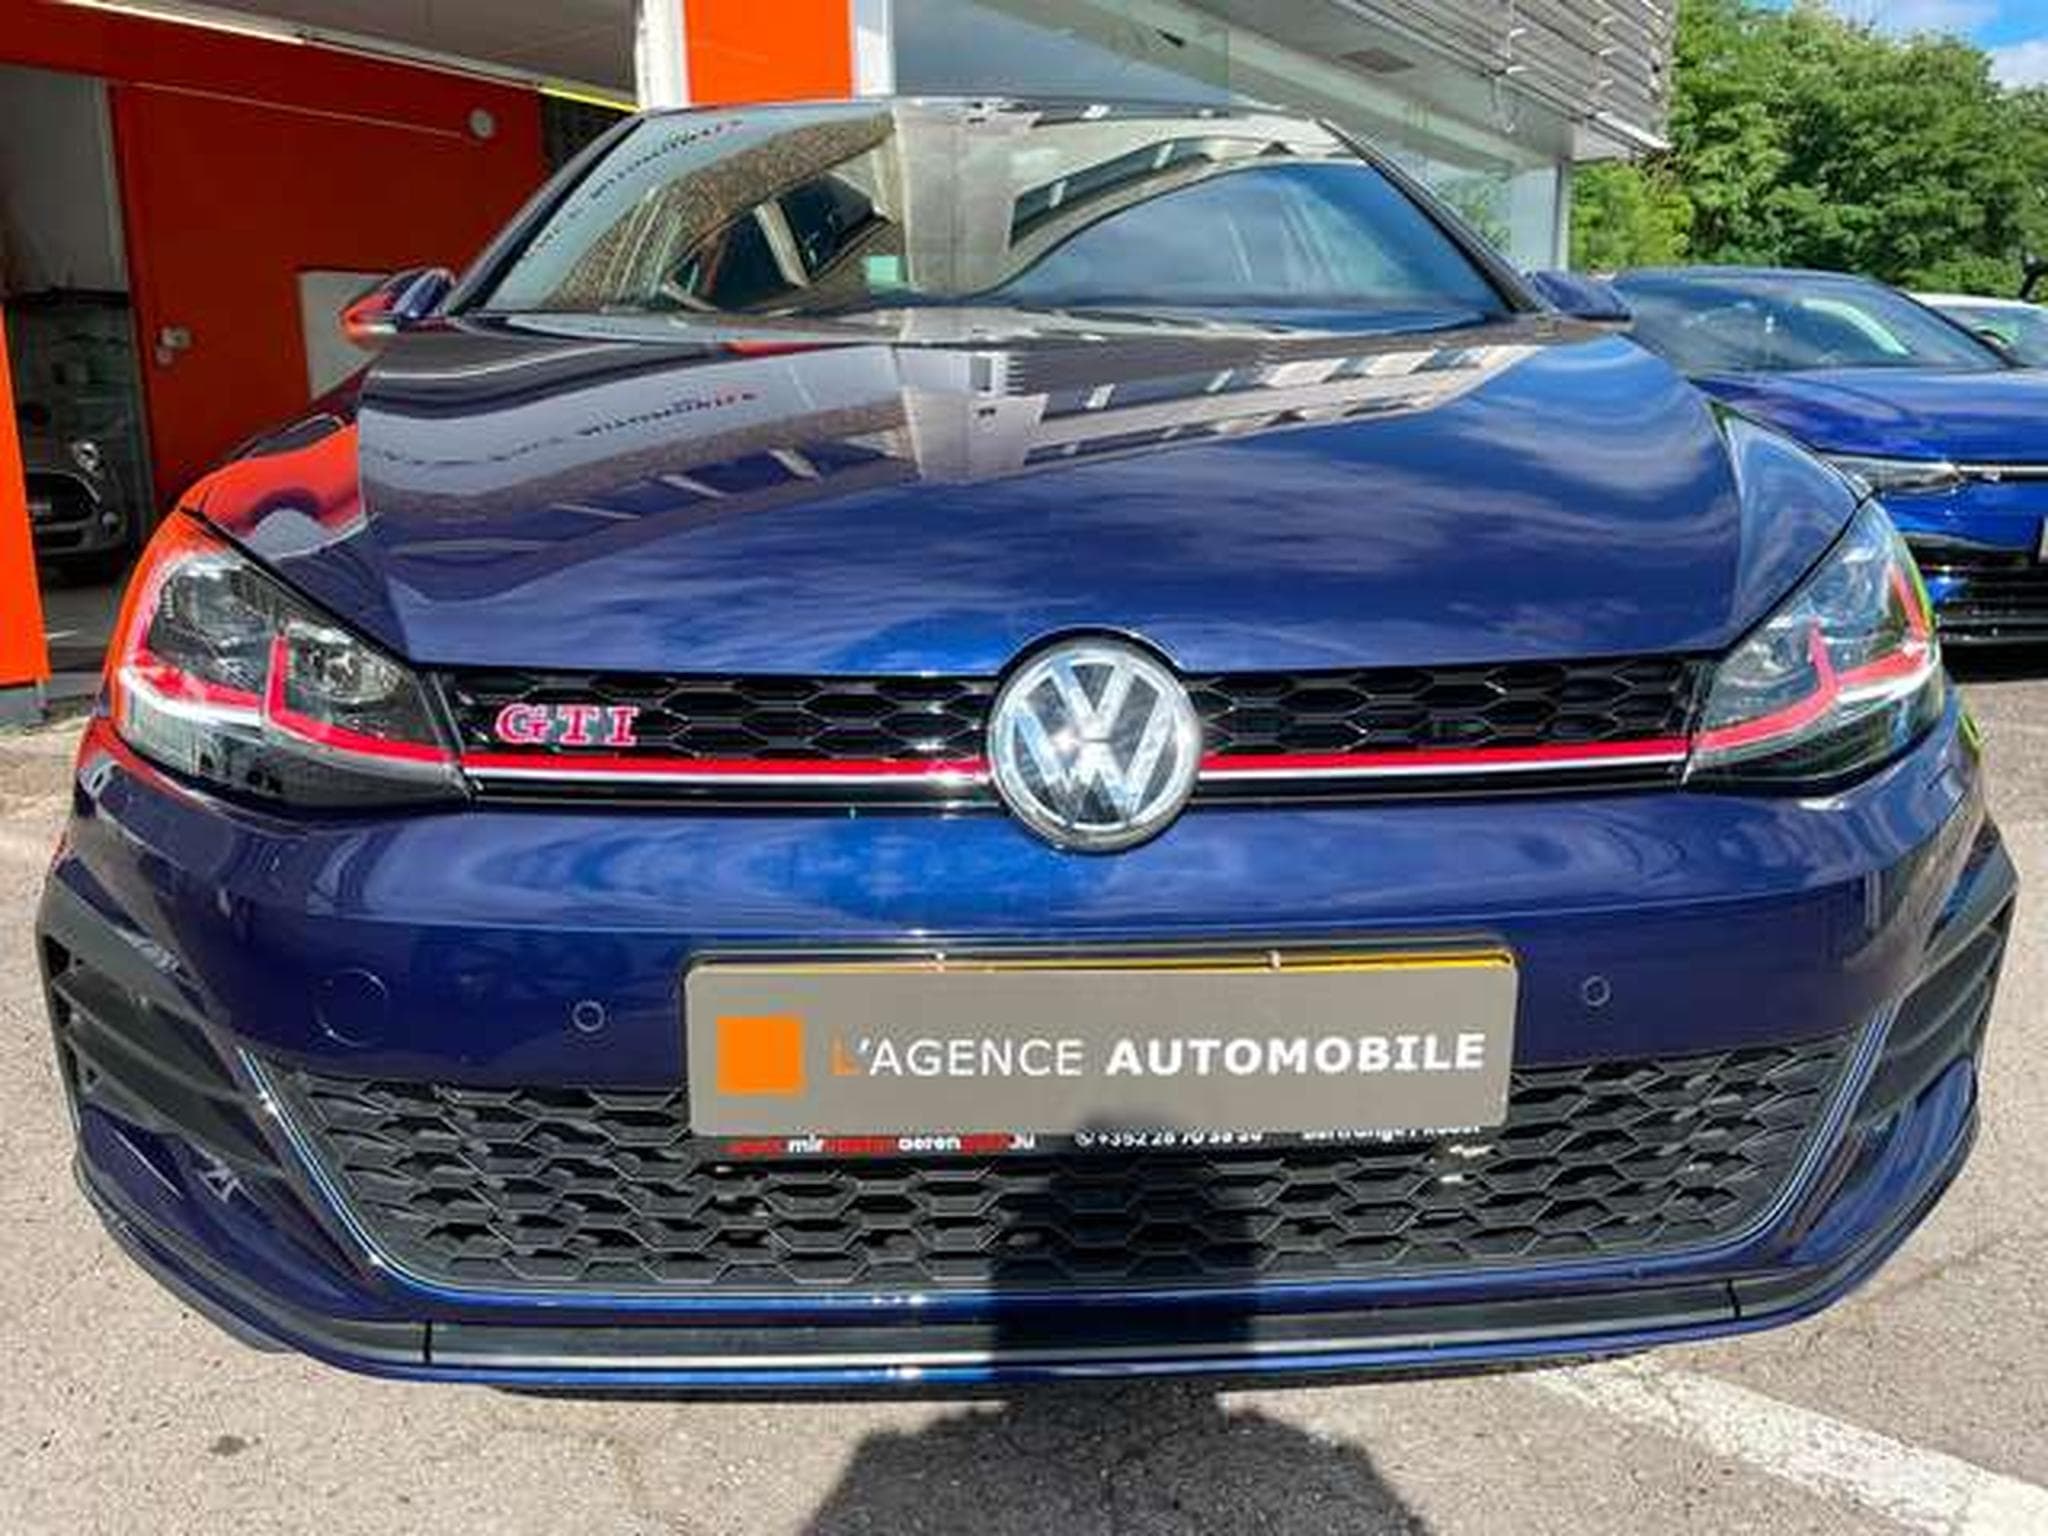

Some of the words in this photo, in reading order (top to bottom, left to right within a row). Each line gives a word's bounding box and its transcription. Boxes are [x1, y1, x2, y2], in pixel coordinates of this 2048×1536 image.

[495, 703, 640, 746] GTI
[831, 1035, 1084, 1077] L'AGENCE
[1105, 1032, 1486, 1076] AUTOMOBILE
